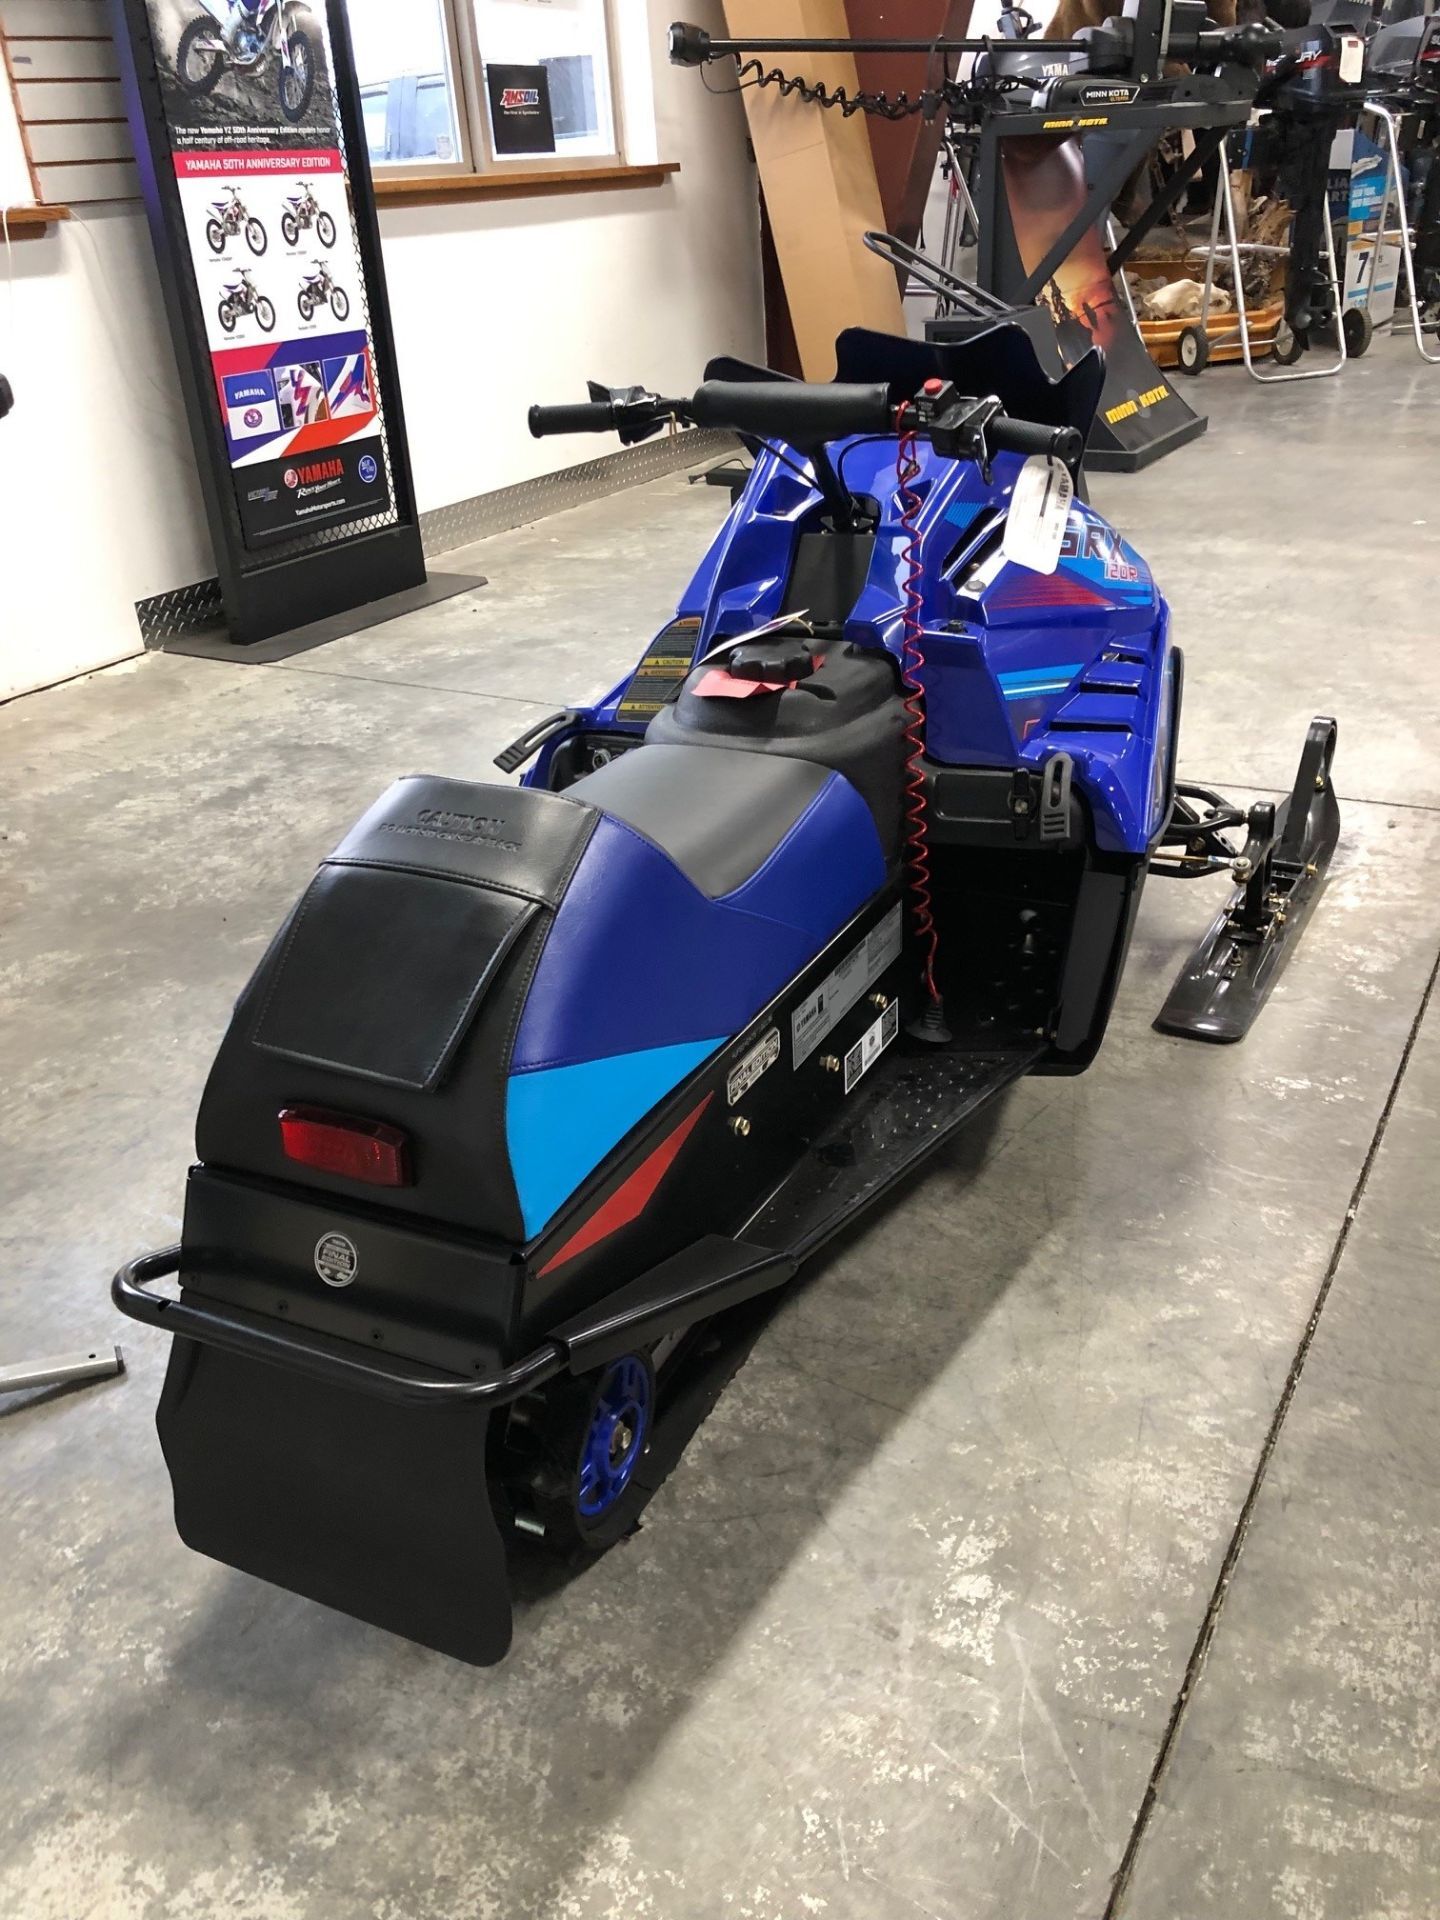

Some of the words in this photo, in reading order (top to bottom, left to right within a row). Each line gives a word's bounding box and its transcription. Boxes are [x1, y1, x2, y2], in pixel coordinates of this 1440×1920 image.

[502, 91, 538, 104] AMSOIL
[1086, 90, 1108, 99] MINN
[1108, 89, 1130, 97] KOTA
[1043, 120, 1075, 129] MINN
[1077, 117, 1109, 127] KOTA
[175, 126, 186, 135] The
[200, 126, 223, 134] Yamaha
[247, 126, 279, 135] Anniversary
[280, 126, 297, 134] Edition
[182, 136, 194, 145] half
[195, 136, 216, 145] century
[217, 136, 223, 144] of
[224, 135, 247, 144] off-road
[185, 158, 221, 171] YAMAHA
[223, 158, 245, 169] 50TH
[246, 157, 300, 169] ANNIVERSARY
[302, 156, 331, 168] EDITION
[1357, 251, 1370, 283] 7
[234, 388, 266, 400] YAMAHA
[1105, 400, 1138, 424] MINN
[1138, 385, 1170, 408] KOTA
[298, 458, 344, 484] YAMAHA
[418, 809, 506, 835] CAUTION
